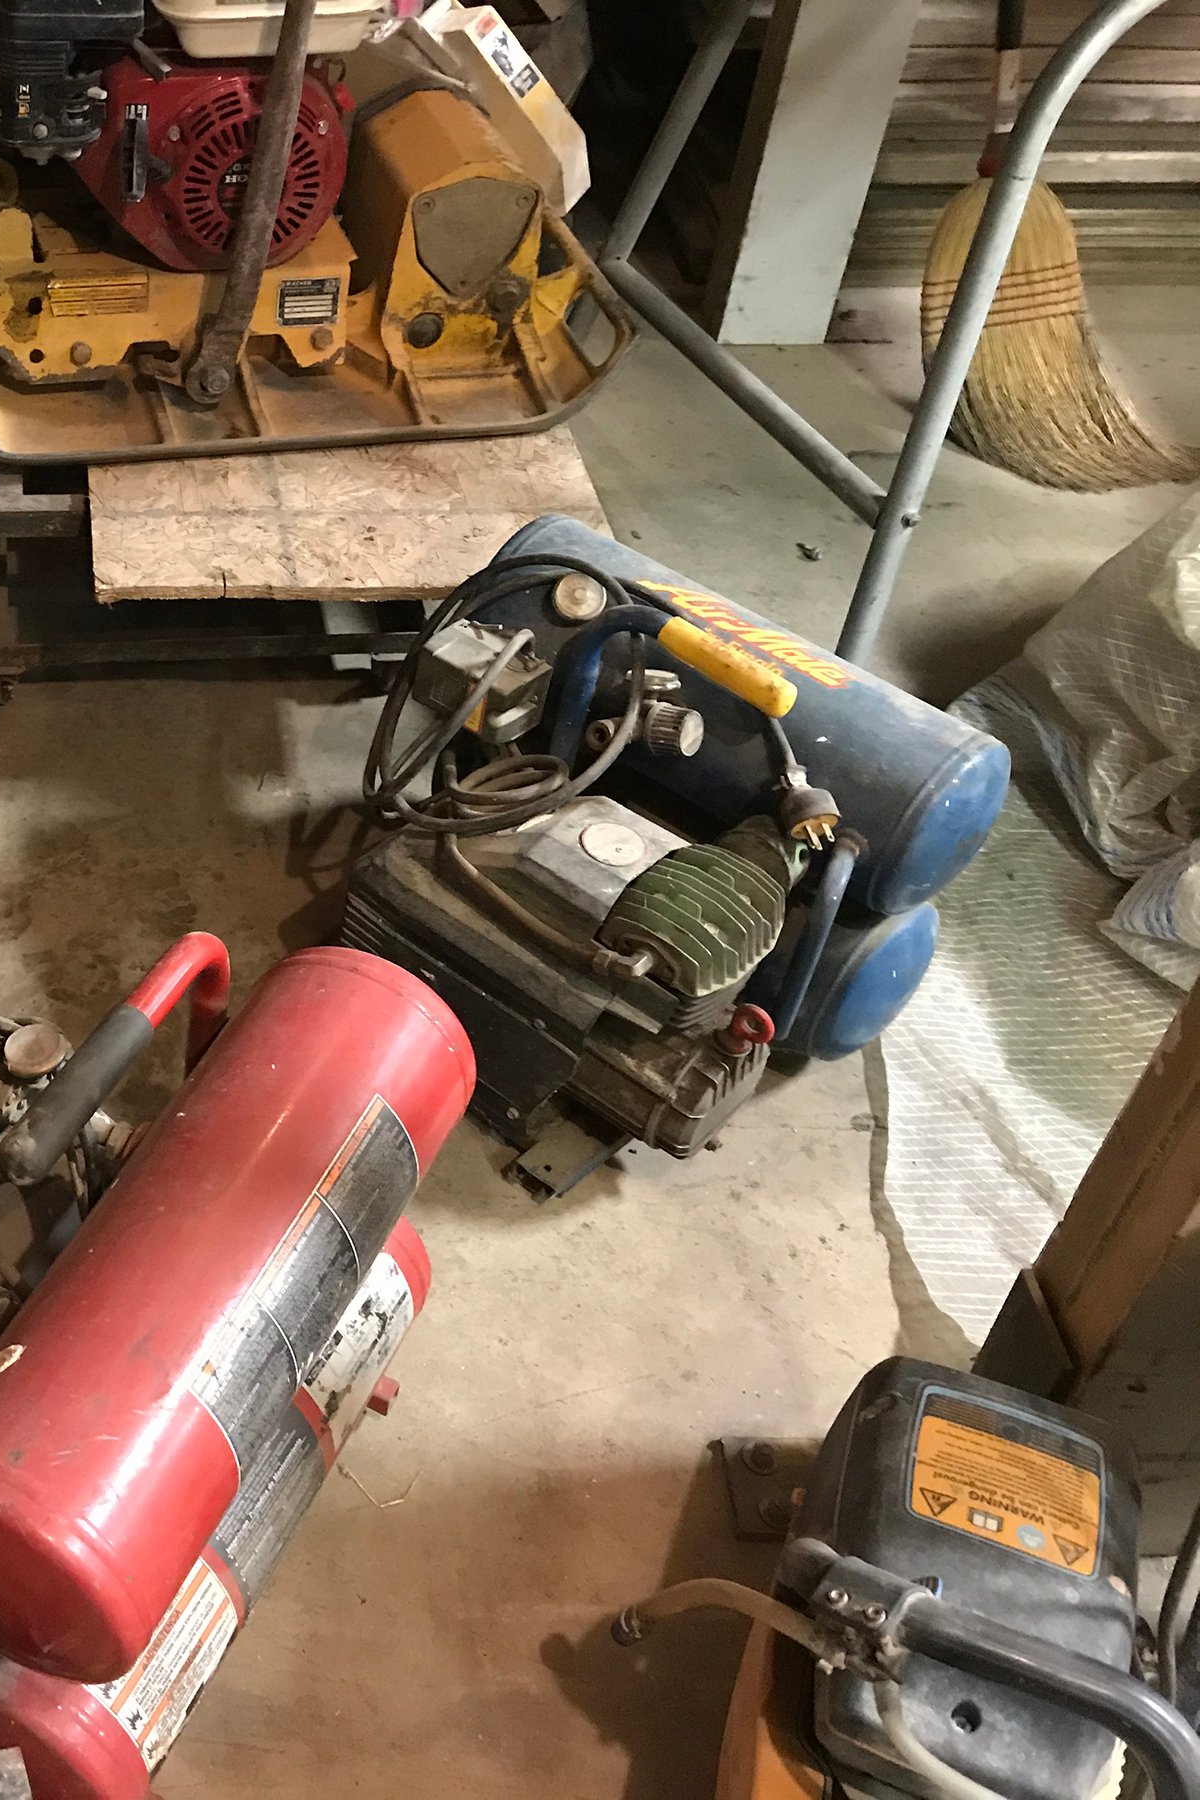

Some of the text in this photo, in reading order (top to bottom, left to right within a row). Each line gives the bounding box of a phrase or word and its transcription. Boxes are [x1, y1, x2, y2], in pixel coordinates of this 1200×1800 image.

[931, 1470, 1080, 1530] Cutters can be dangerous!
[966, 1489, 1044, 1525] WARNING
[141, 1607, 183, 1665] ADVERTENCIA
